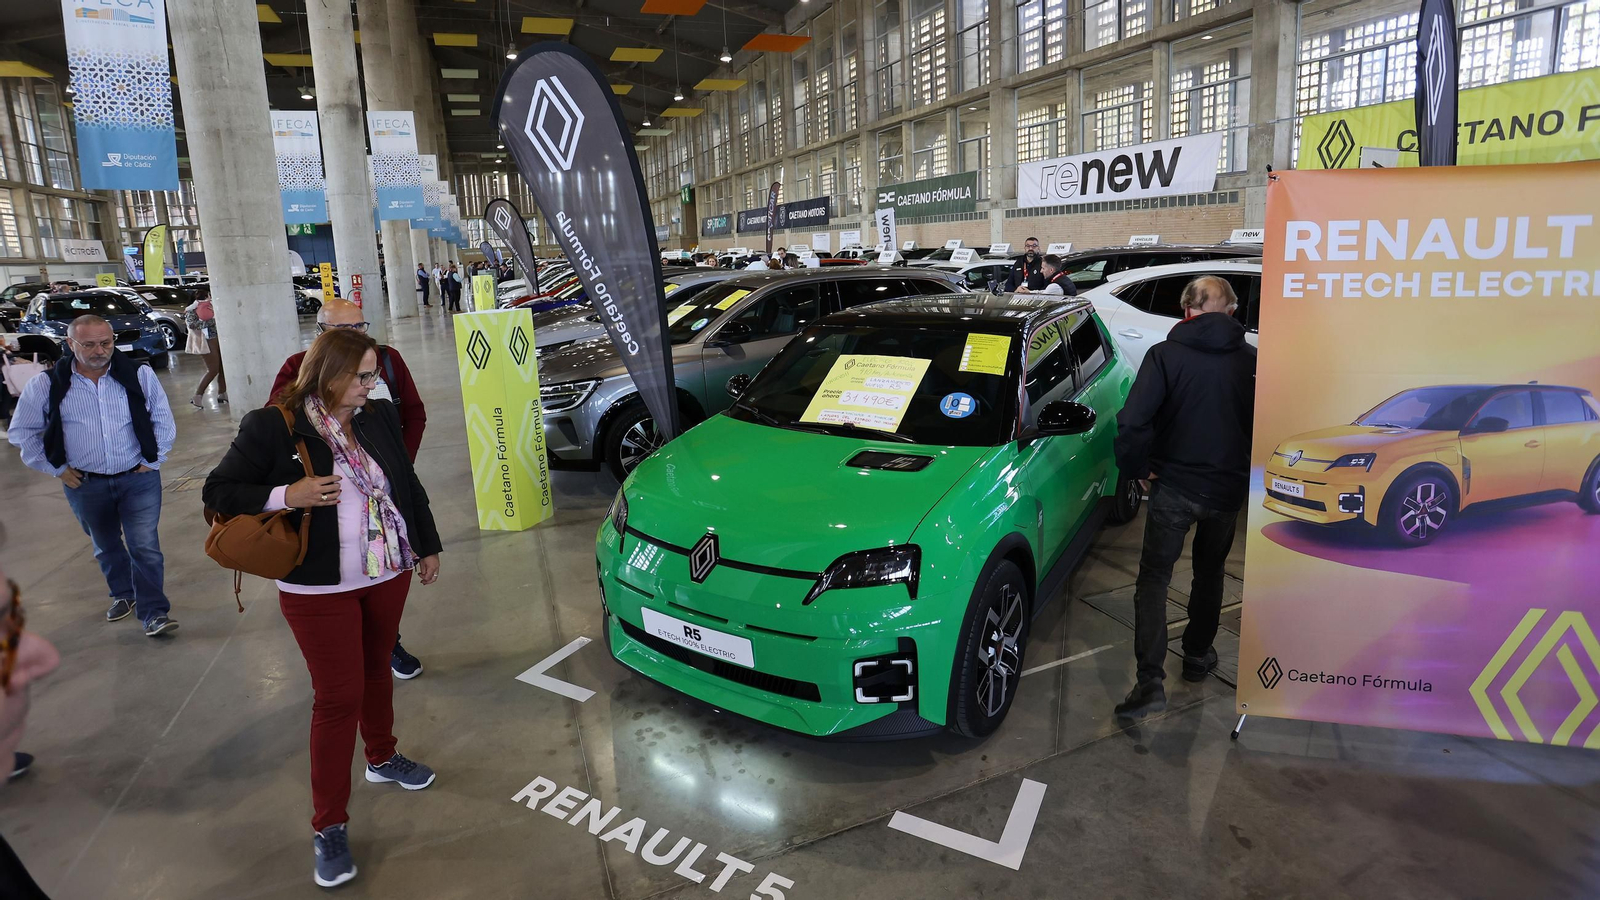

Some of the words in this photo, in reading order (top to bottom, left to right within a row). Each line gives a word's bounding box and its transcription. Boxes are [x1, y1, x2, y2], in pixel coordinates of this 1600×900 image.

[272, 119, 313, 129] IFECA
[372, 119, 410, 128] IFECA
[1397, 110, 1564, 151] CTANO
[123, 153, 157, 161] Diputación
[134, 161, 152, 169] Cádiz
[1040, 146, 1182, 200] renew
[897, 193, 931, 207] CAETANO
[932, 186, 971, 203] FÓRMULA
[1283, 214, 1594, 262] RENAULT
[1282, 271, 1421, 298] E-TECH
[1430, 270, 1600, 298] ELECTRI
[887, 363, 916, 372] Fórmula
[493, 407, 508, 460] Fórmula
[531, 399, 544, 452] Fórmula
[501, 464, 515, 518] Caetano
[538, 453, 550, 507] Caetano
[1274, 481, 1295, 493] RENAULT
[657, 628, 681, 642] E-TECH
[682, 637, 700, 649] 100%
[700, 643, 736, 660] ELECTRIC
[683, 625, 702, 642] R5
[1287, 669, 1357, 686] Caetano
[1362, 674, 1433, 692] Fórmula
[510, 775, 755, 893] RENAULT
[749, 871, 796, 900] 5
